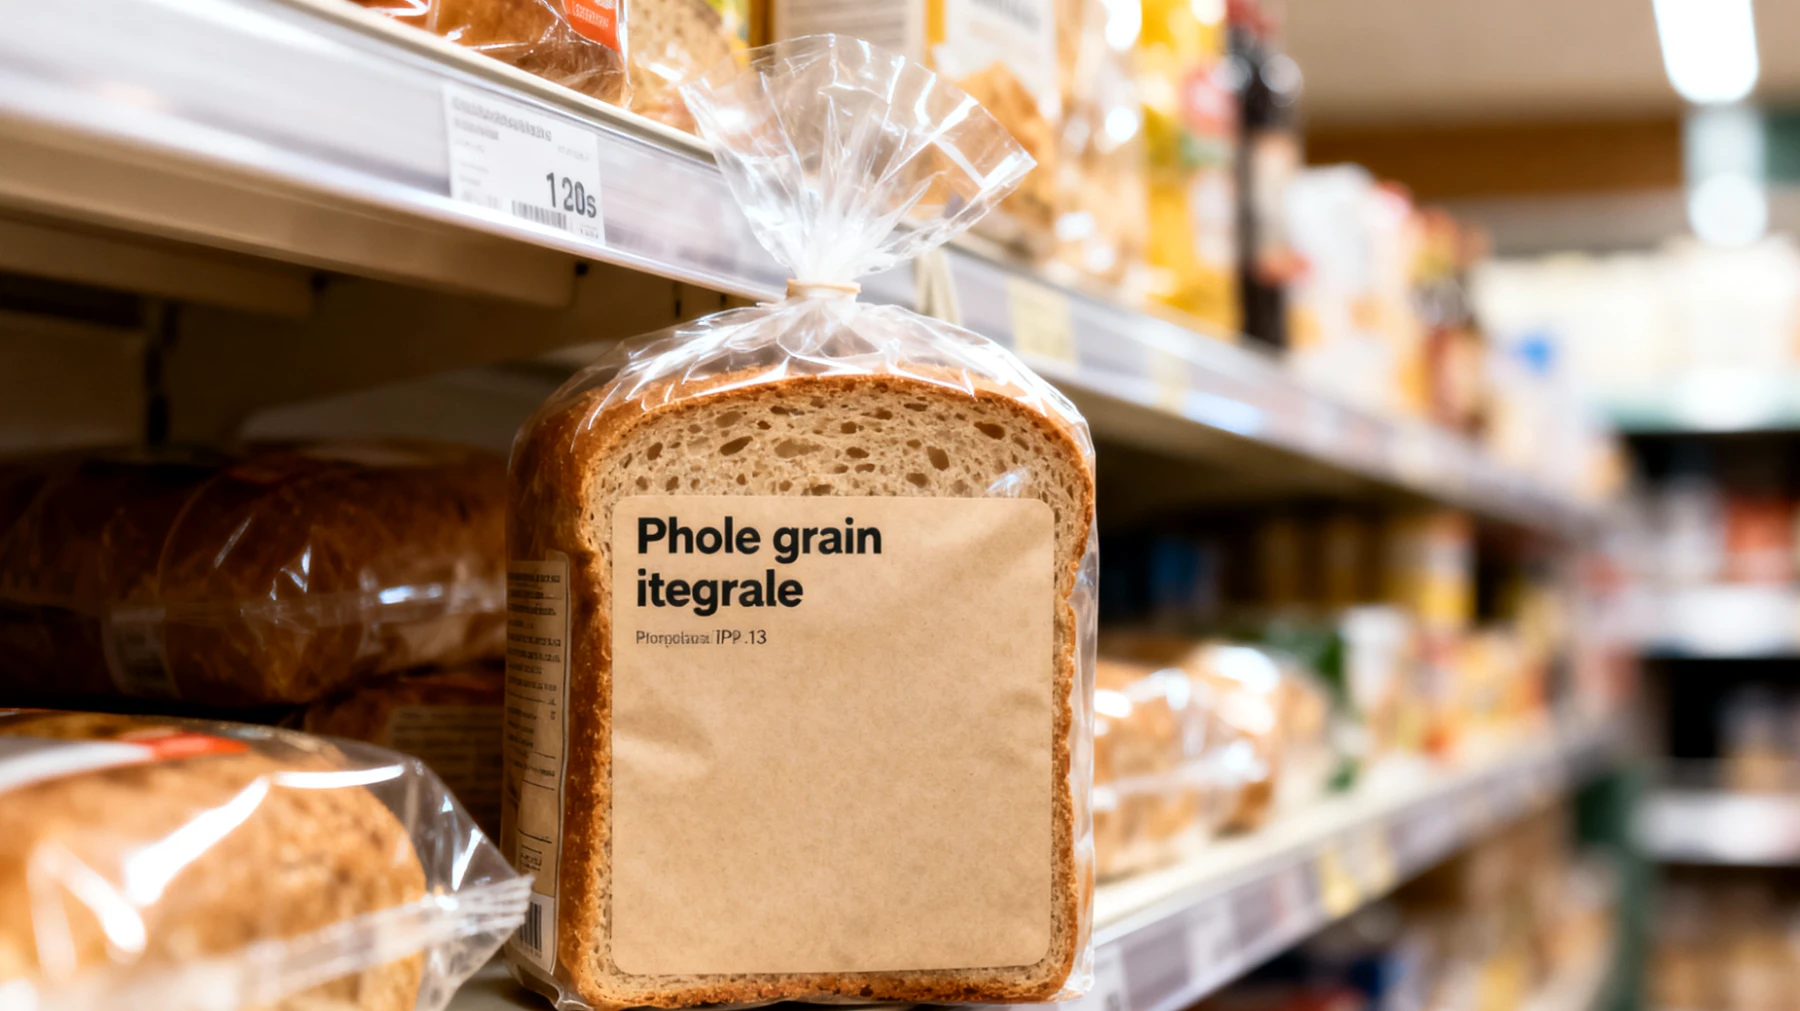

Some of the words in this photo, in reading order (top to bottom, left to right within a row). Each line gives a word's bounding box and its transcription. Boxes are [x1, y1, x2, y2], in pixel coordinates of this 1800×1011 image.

[637, 516, 761, 554] Phole
[773, 517, 882, 564] grain
[637, 568, 804, 617] itegrale
